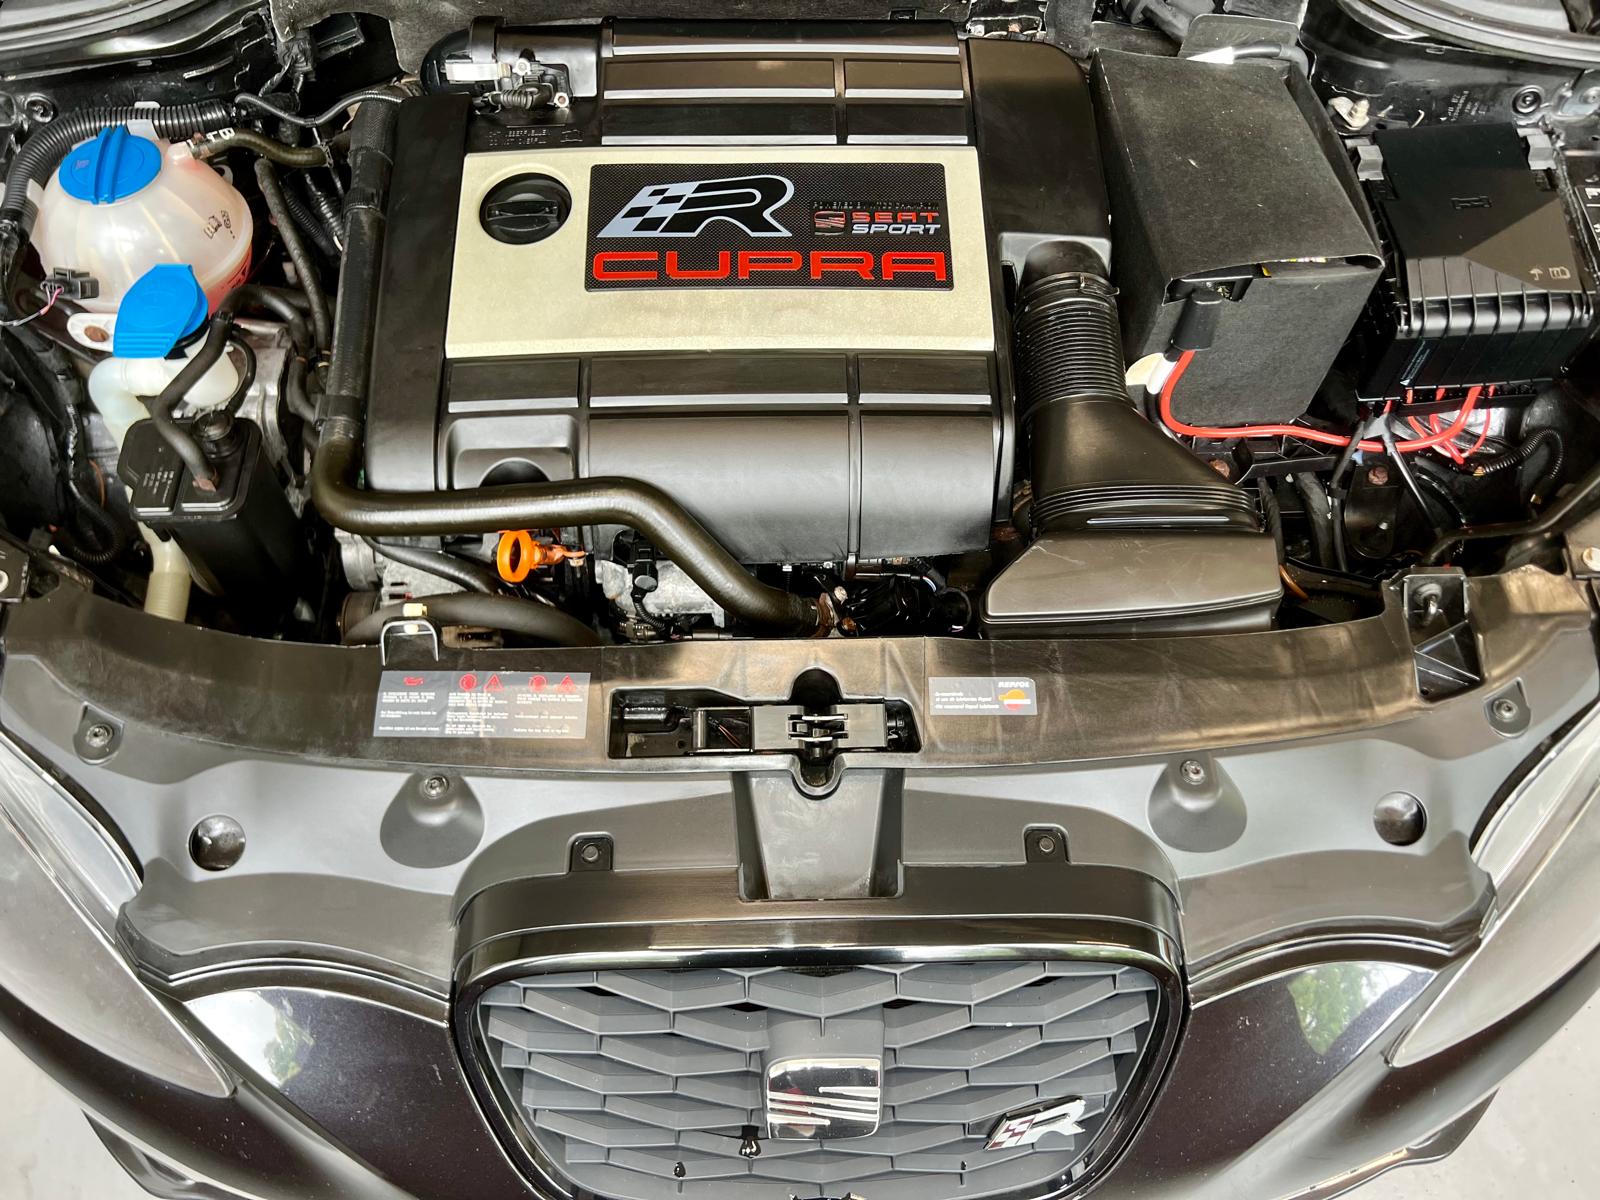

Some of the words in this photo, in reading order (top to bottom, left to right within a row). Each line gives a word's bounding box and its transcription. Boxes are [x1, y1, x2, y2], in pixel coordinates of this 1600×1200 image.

[851, 211, 940, 223] SEAT
[851, 224, 942, 235] SPORT
[592, 250, 947, 281] CUPRA
